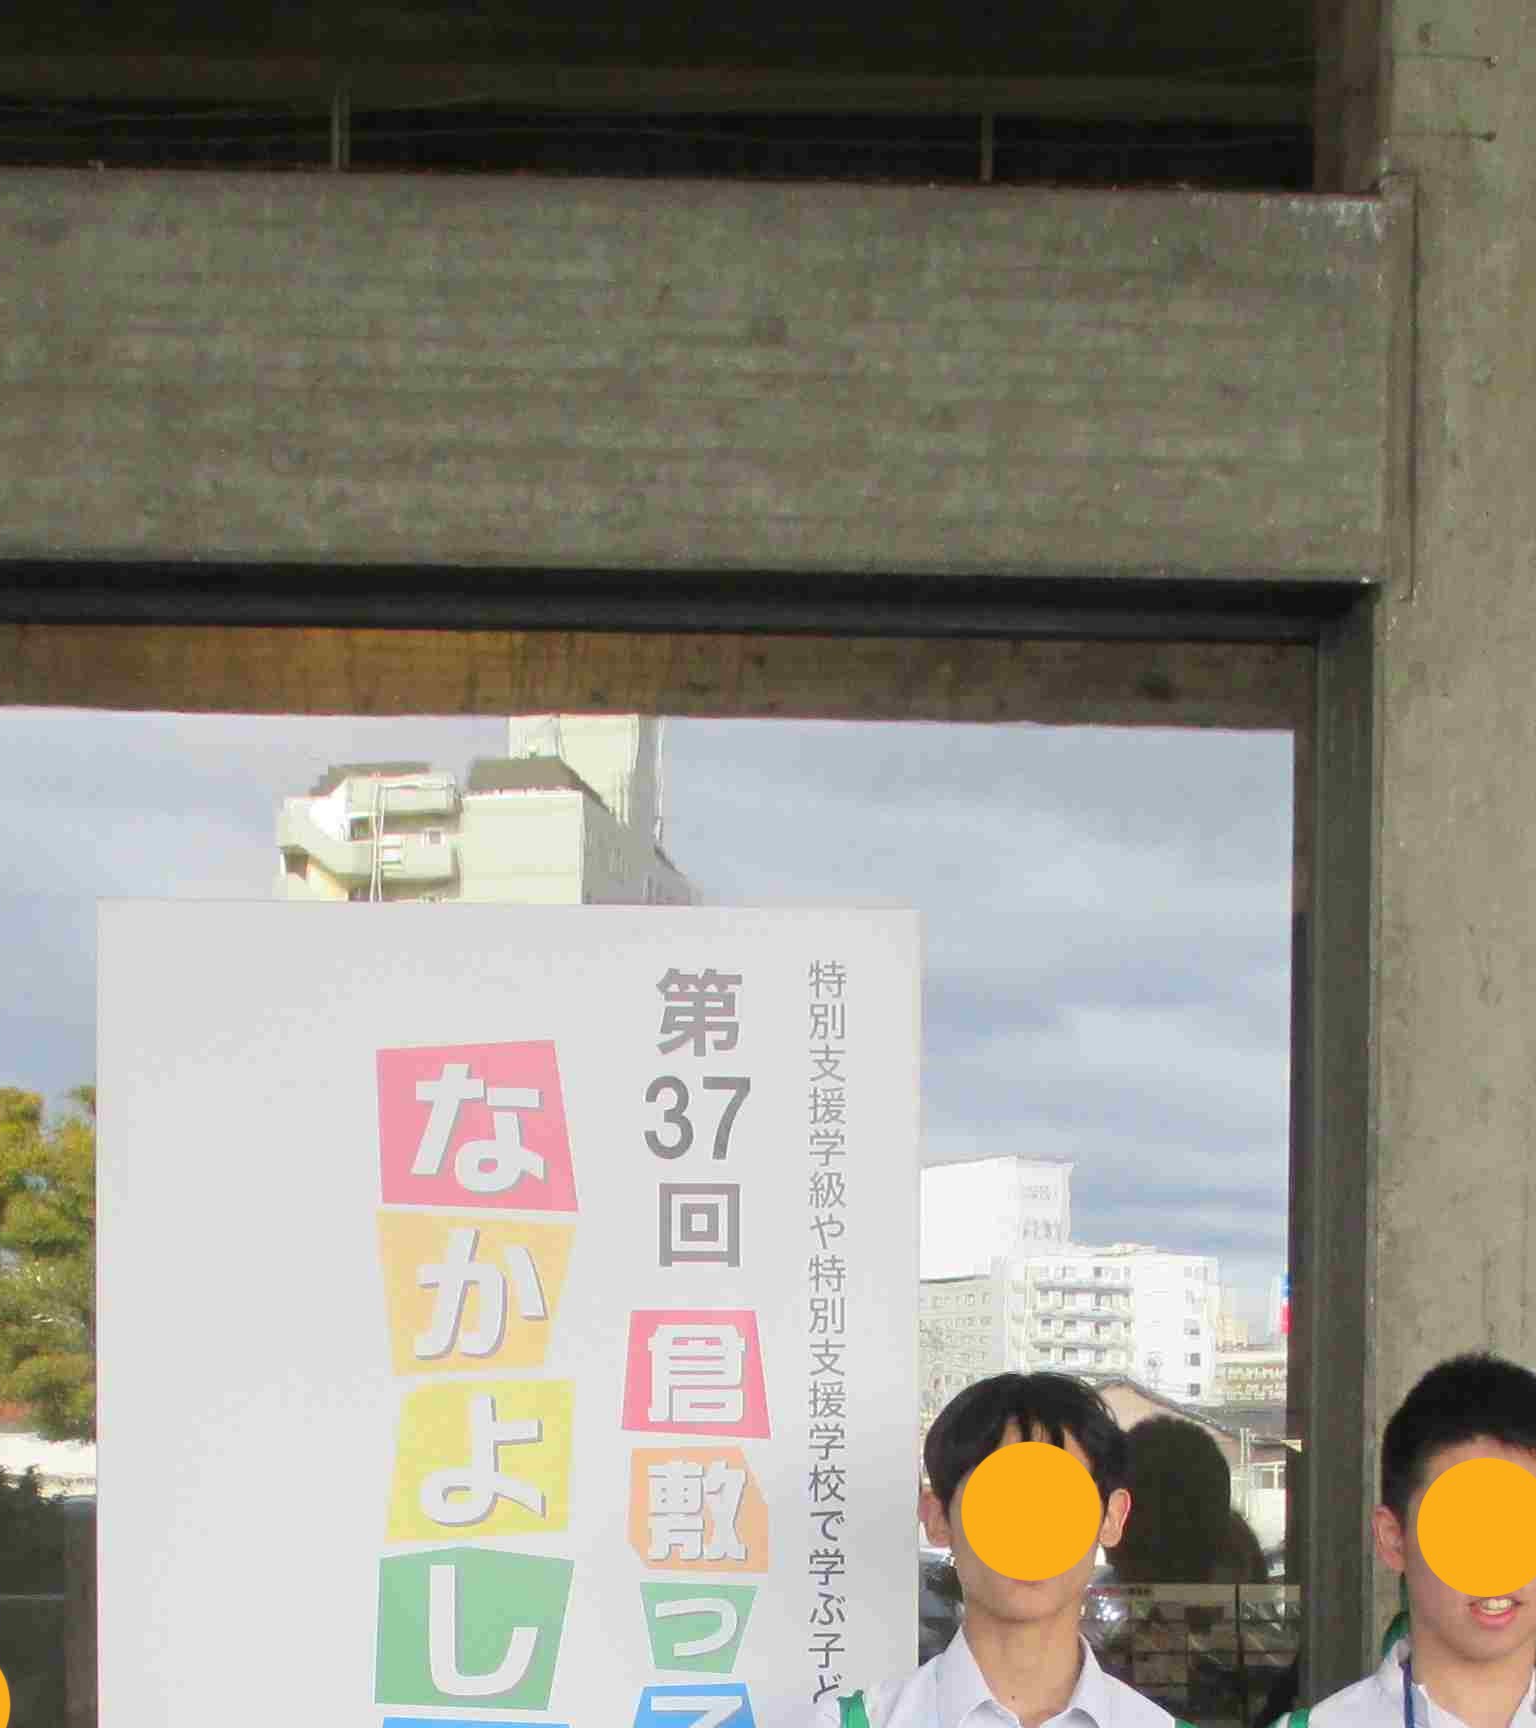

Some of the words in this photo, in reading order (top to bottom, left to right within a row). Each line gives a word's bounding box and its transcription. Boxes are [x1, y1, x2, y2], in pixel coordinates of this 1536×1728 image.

[644, 967, 751, 1268] 第37回
[807, 959, 848, 1704] 特別支援学級や特別支援学校で学ぶ子ど
